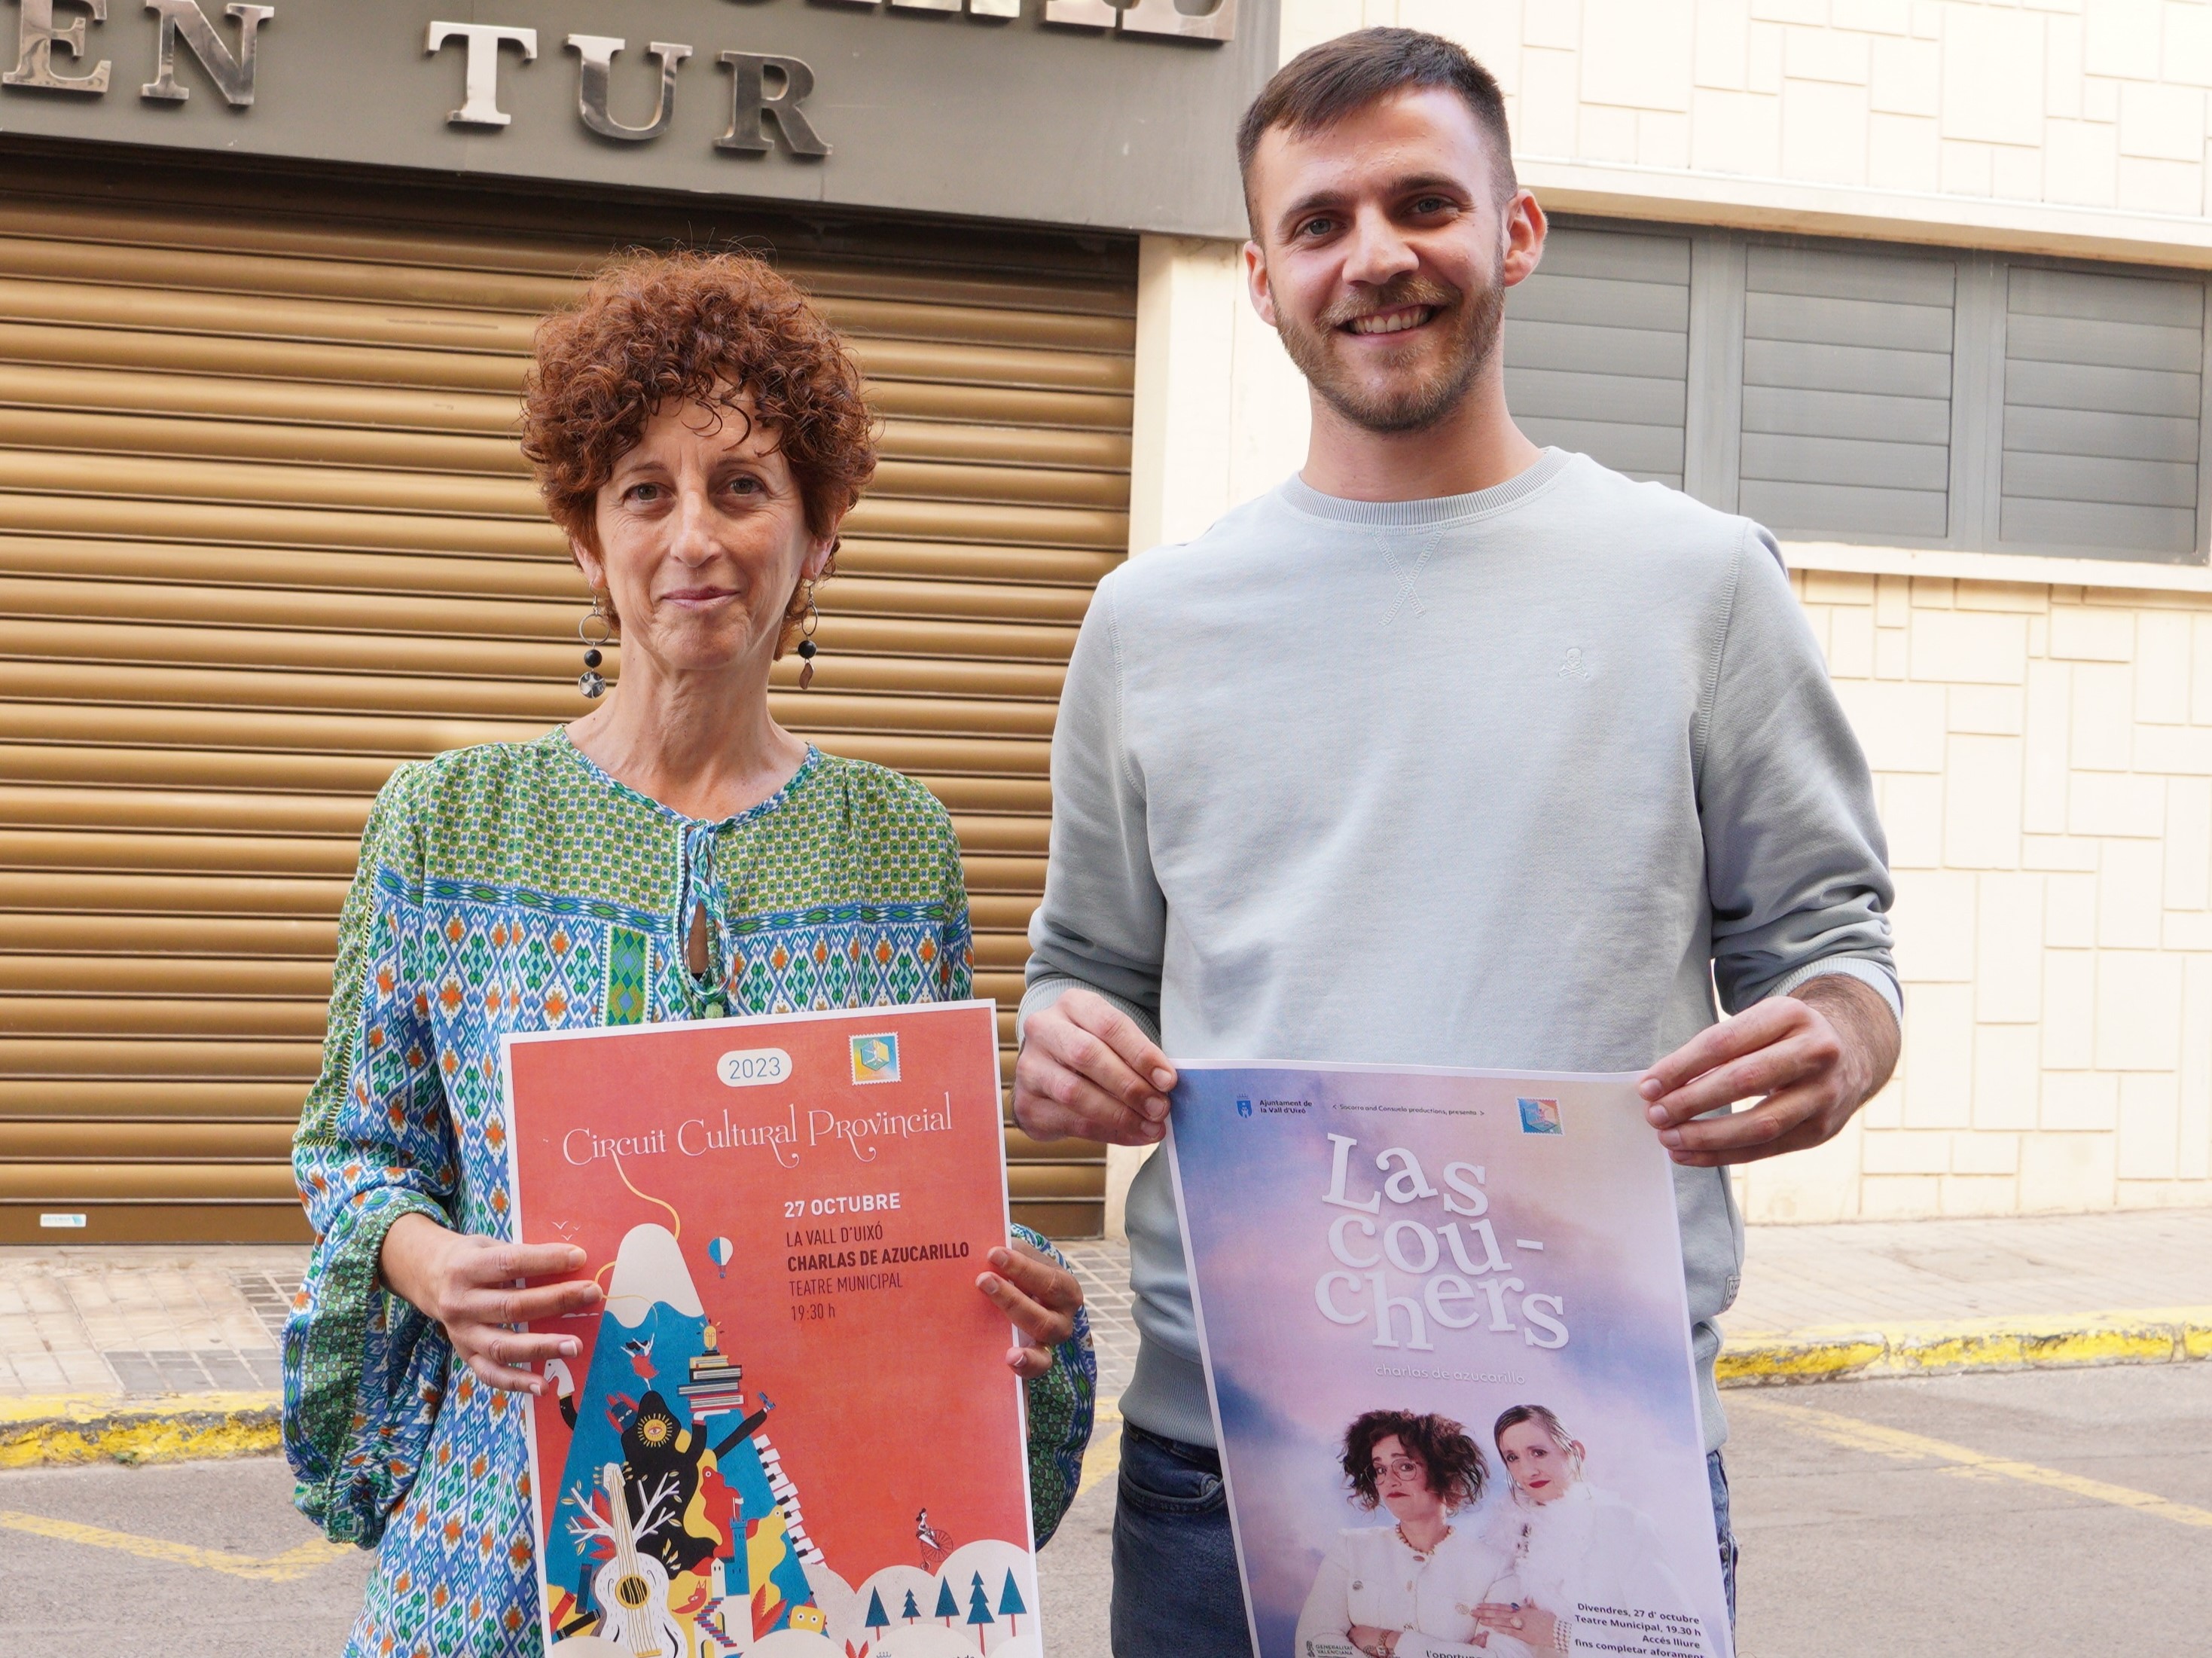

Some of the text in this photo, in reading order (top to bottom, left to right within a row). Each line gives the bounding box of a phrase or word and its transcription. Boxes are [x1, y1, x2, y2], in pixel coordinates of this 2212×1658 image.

[426, 20, 833, 156] TUR
[729, 1056, 781, 1079] 2023
[1259, 1099, 1301, 1108] Ajuntament
[563, 1091, 953, 1169] Circuit Cultural Provincial
[1321, 1133, 1489, 1217] Las
[785, 1192, 902, 1218] 27 OCTUBRE
[786, 1220, 883, 1247] LA VALL D'UIXÓ
[1327, 1213, 1544, 1276] cou-
[788, 1241, 969, 1272] CHARLAS DE AZUCARILLO
[789, 1272, 903, 1297] TEATRE MUNICIPAL
[791, 1302, 835, 1321] 19:30 h
[1314, 1270, 1570, 1351] chers
[1375, 1363, 1526, 1385] charlas de azucarillo
[1575, 1614, 1701, 1638] Teatre Municipal, 19.30 h
[1578, 1602, 1631, 1618] Divendres,
[1634, 1609, 1646, 1618] 27
[1660, 1613, 1700, 1625] octubre
[1575, 1638, 1594, 1648] fins
[1596, 1642, 1647, 1655] completar
[1673, 1635, 1701, 1649] lliure
